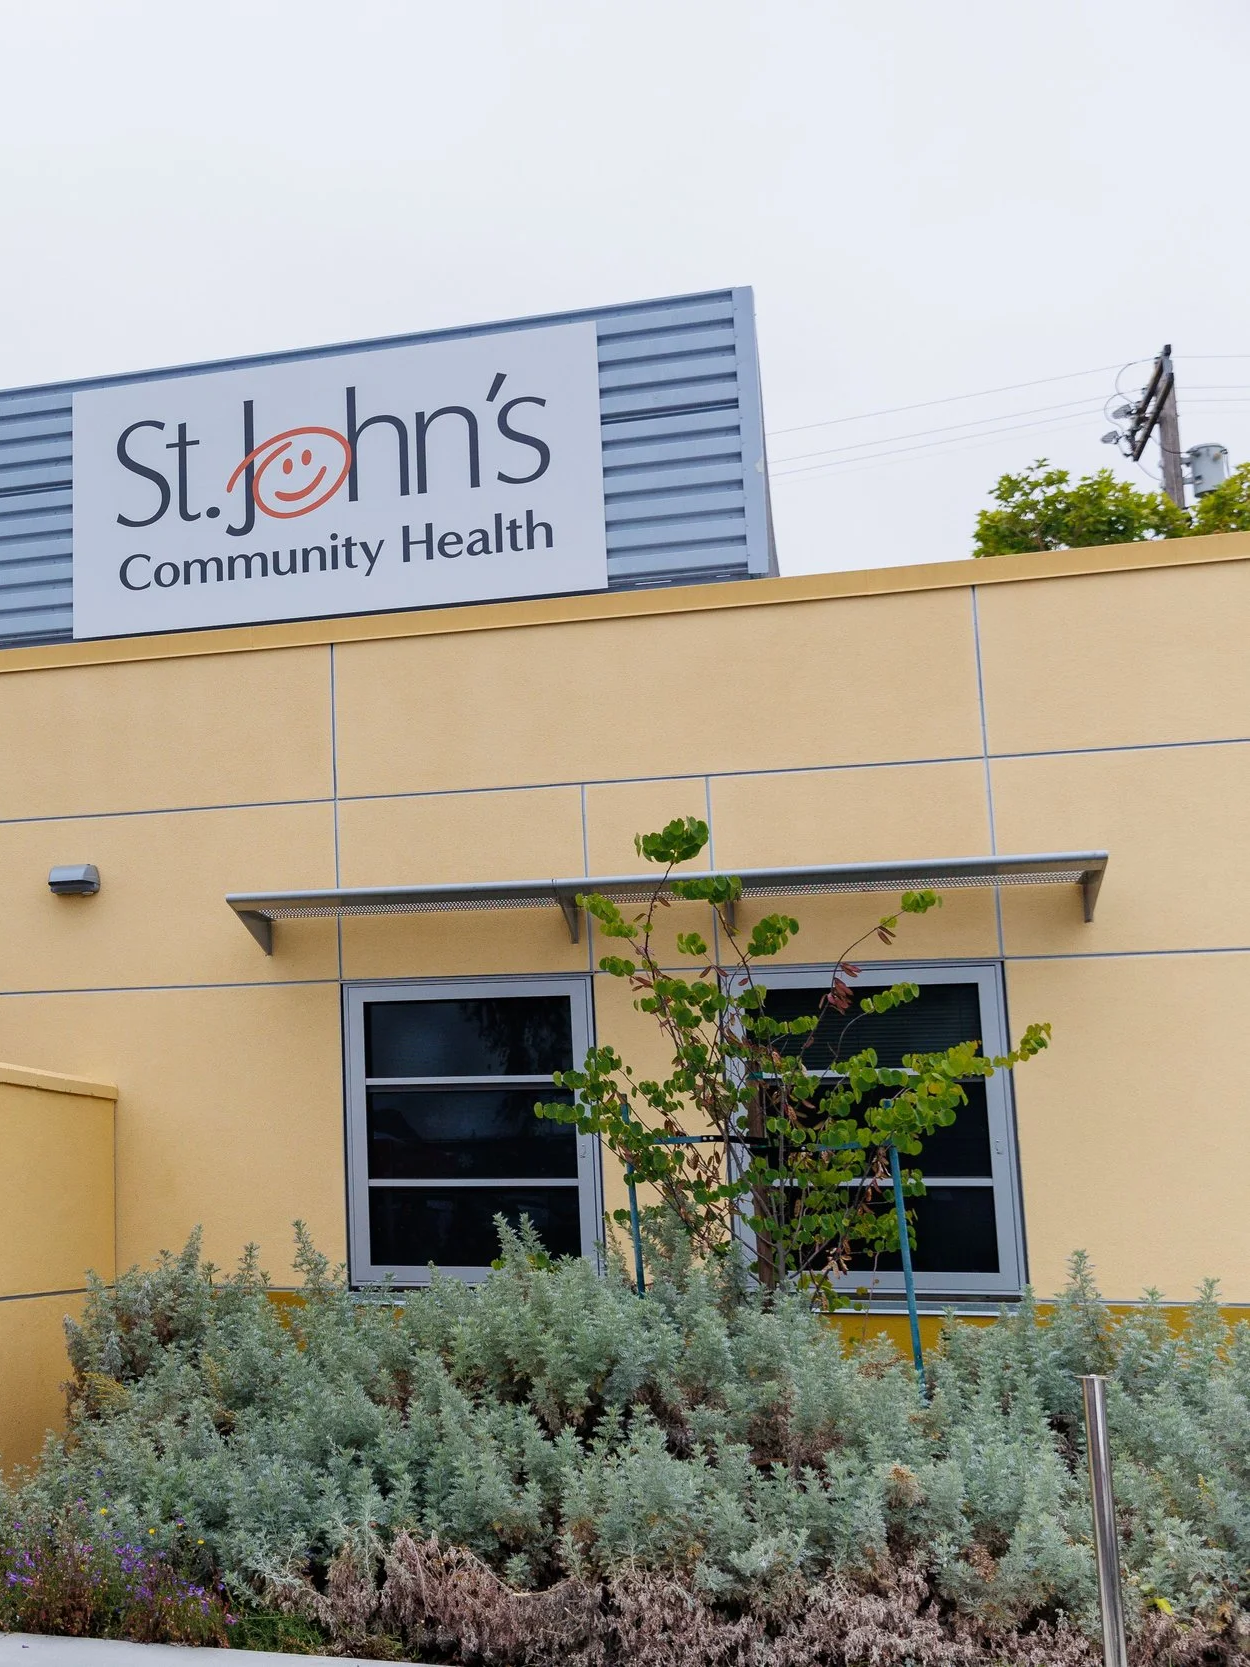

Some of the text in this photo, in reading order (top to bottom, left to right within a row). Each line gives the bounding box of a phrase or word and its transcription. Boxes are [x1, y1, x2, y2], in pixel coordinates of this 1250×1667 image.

[116, 372, 551, 537] St. John's
[119, 508, 554, 591] Community Health
